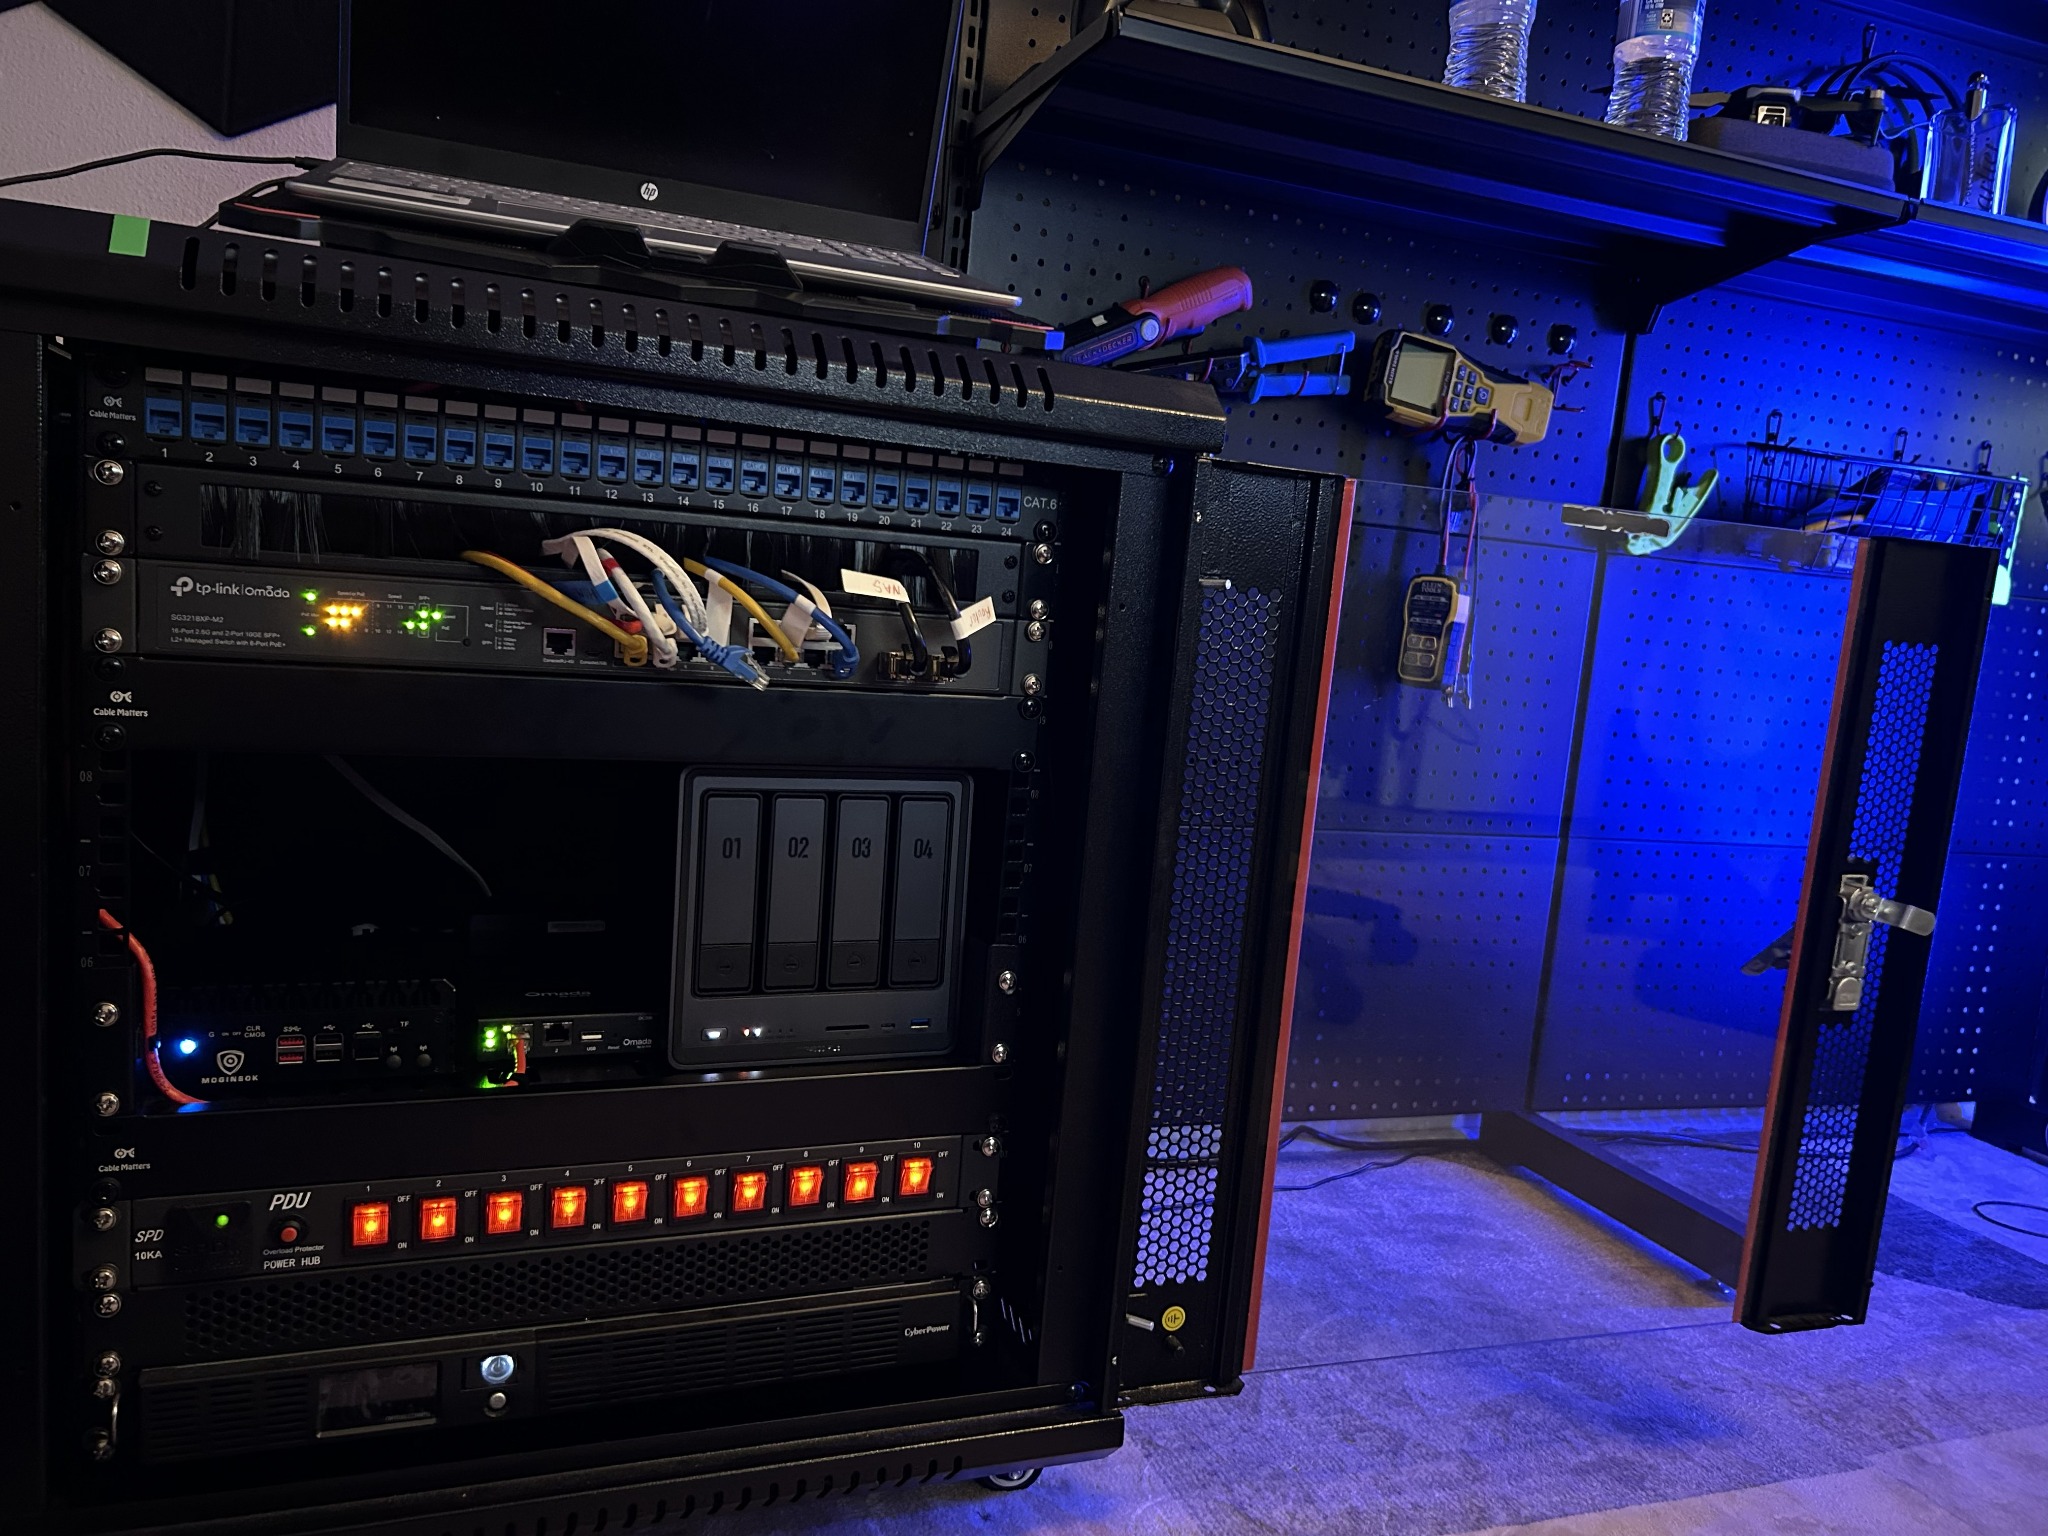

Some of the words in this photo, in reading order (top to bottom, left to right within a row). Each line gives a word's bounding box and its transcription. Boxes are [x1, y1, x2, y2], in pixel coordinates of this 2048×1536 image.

[642, 183, 657, 200] hp
[89, 409, 109, 420] Cable
[110, 412, 136, 422] Matters
[162, 448, 168, 458] 1
[206, 452, 214, 462] 2
[250, 456, 258, 466] 3
[292, 460, 300, 470] 4
[335, 464, 342, 474] 5
[374, 468, 382, 478] 6
[416, 471, 424, 481] 7
[456, 474, 464, 485] 8
[494, 478, 502, 488] 9
[530, 482, 544, 492] 10
[569, 486, 581, 496] 11
[605, 489, 618, 500] 12
[642, 492, 654, 503] 13
[678, 496, 690, 506] 14
[712, 500, 725, 510] 15
[748, 502, 759, 512] 16
[781, 506, 792, 516] 17
[814, 509, 826, 520] 18
[847, 512, 858, 522] 19
[878, 515, 890, 526] 20
[910, 518, 922, 528] 21
[941, 521, 952, 532] 22
[972, 524, 982, 534] 23
[1001, 526, 1012, 536] 24
[1024, 496, 1057, 510] CAT.6
[196, 582, 240, 596] tp-link
[873, 580, 901, 595] NAS
[93, 706, 115, 717] Cable
[116, 708, 148, 718] Matters
[79, 770, 93, 783] 08
[722, 837, 742, 859] 01
[788, 837, 808, 859] 02
[852, 837, 871, 858] 03
[914, 838, 933, 859] 04
[79, 866, 92, 877] 07
[80, 957, 93, 968] 06
[623, 1038, 652, 1046] Omada
[201, 1075, 258, 1084] MOGINSOK
[98, 1163, 119, 1173] Cable
[121, 1162, 151, 1171] Matters
[654, 1173, 667, 1181] OFF
[269, 1192, 312, 1211] PDU
[135, 1228, 164, 1243] SPD
[134, 1250, 163, 1261] 10KA
[262, 1246, 294, 1256] Overload
[295, 1244, 325, 1254] Protector
[263, 1258, 295, 1270] POWER
[301, 1255, 321, 1266] HUB
[904, 1323, 950, 1338] CyberPower
